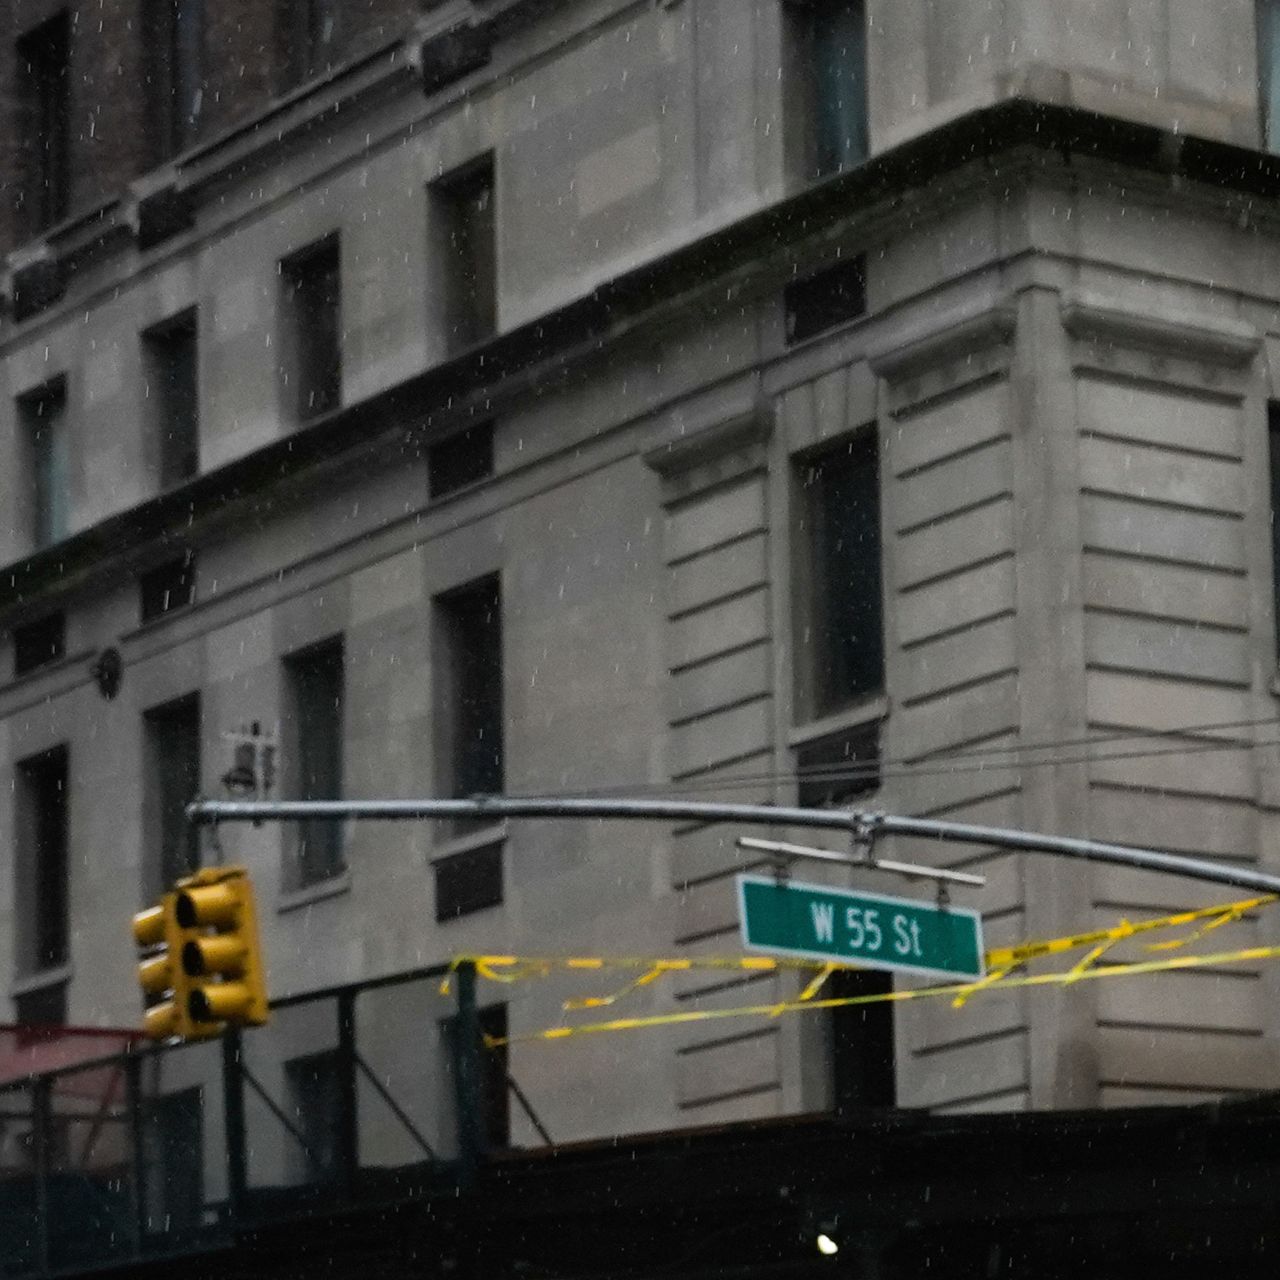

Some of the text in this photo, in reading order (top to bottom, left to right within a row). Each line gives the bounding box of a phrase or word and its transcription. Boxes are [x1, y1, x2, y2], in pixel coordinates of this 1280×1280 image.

[810, 901, 922, 957] W 55 St
